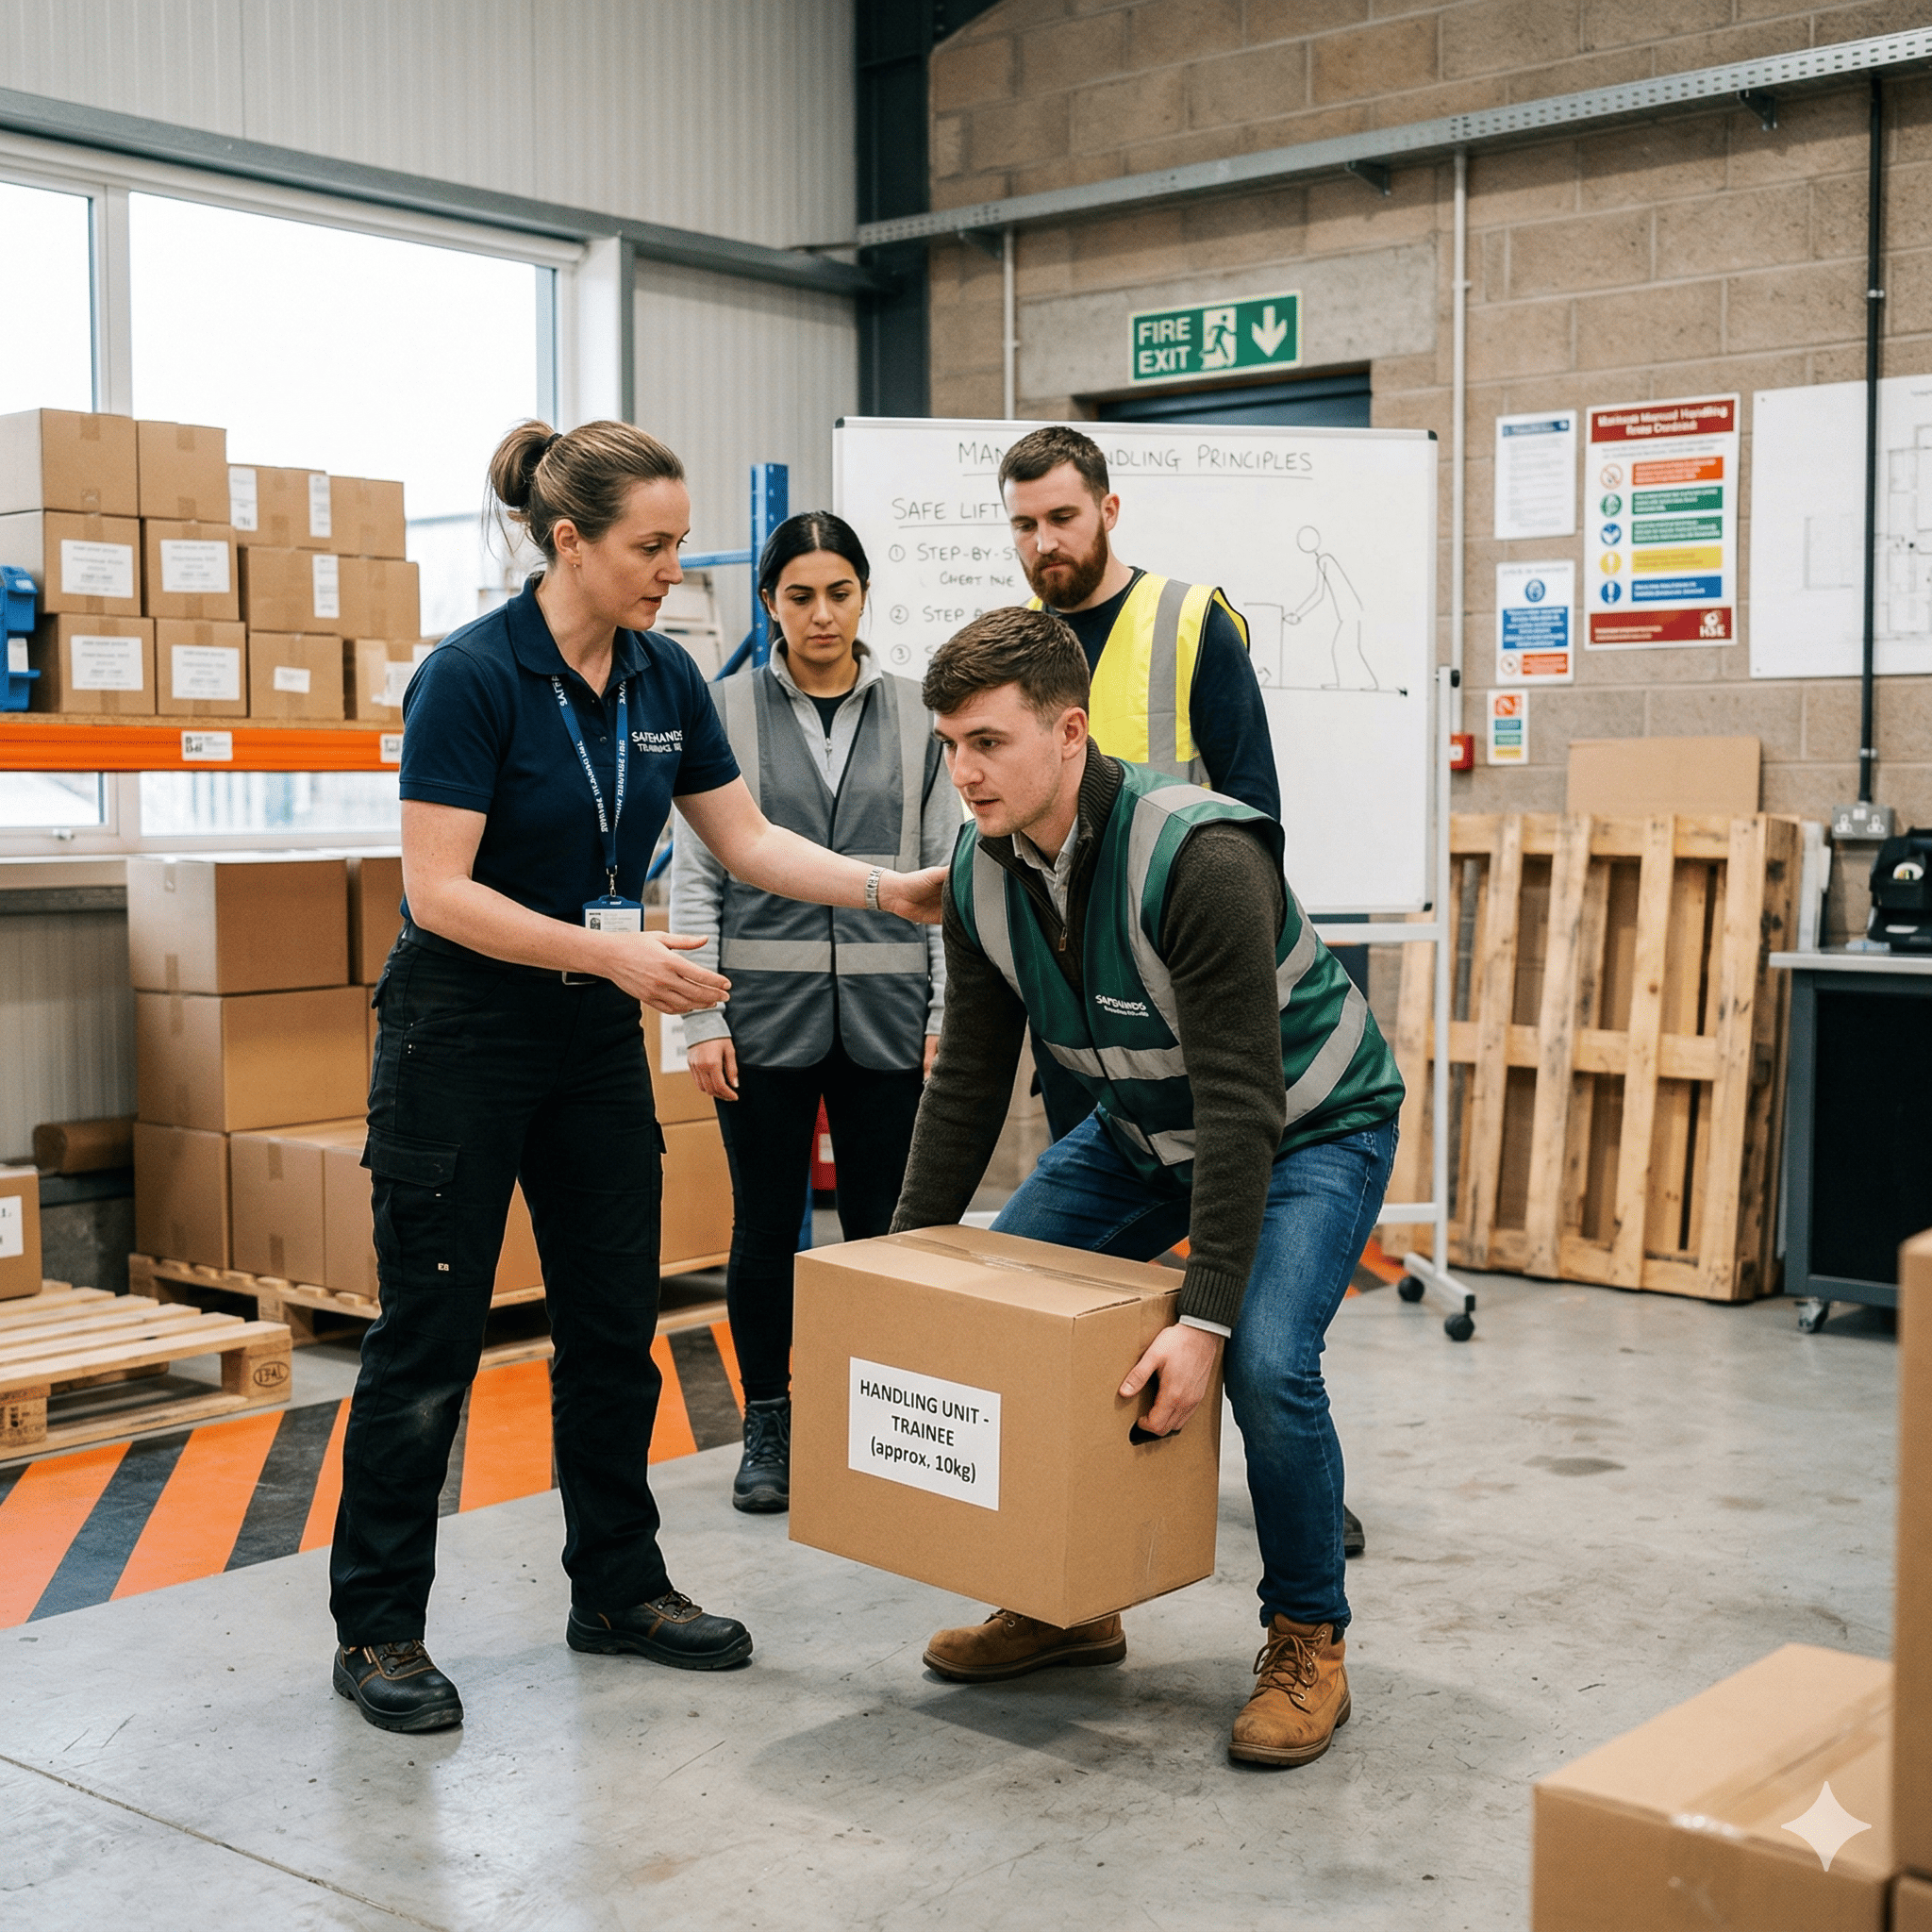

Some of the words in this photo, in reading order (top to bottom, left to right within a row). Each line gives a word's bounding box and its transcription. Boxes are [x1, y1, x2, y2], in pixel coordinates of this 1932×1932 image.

[1138, 316, 1191, 345] FIRE
[1139, 345, 1191, 374] EXIT
[958, 441, 1006, 465] MAN
[1104, 448, 1181, 472] NDLING
[1197, 444, 1313, 472] PRINCIPLES
[891, 497, 946, 520] SAFE
[917, 542, 1018, 561] STEP-BY-ST
[923, 606, 964, 623] STEP
[860, 1379, 938, 1414] HANDLING
[942, 1400, 979, 1424] UNIT
[891, 1415, 954, 1446] TRAINEE
[871, 1436, 931, 1469] (approx,
[935, 1455, 976, 1484] 10kg)
